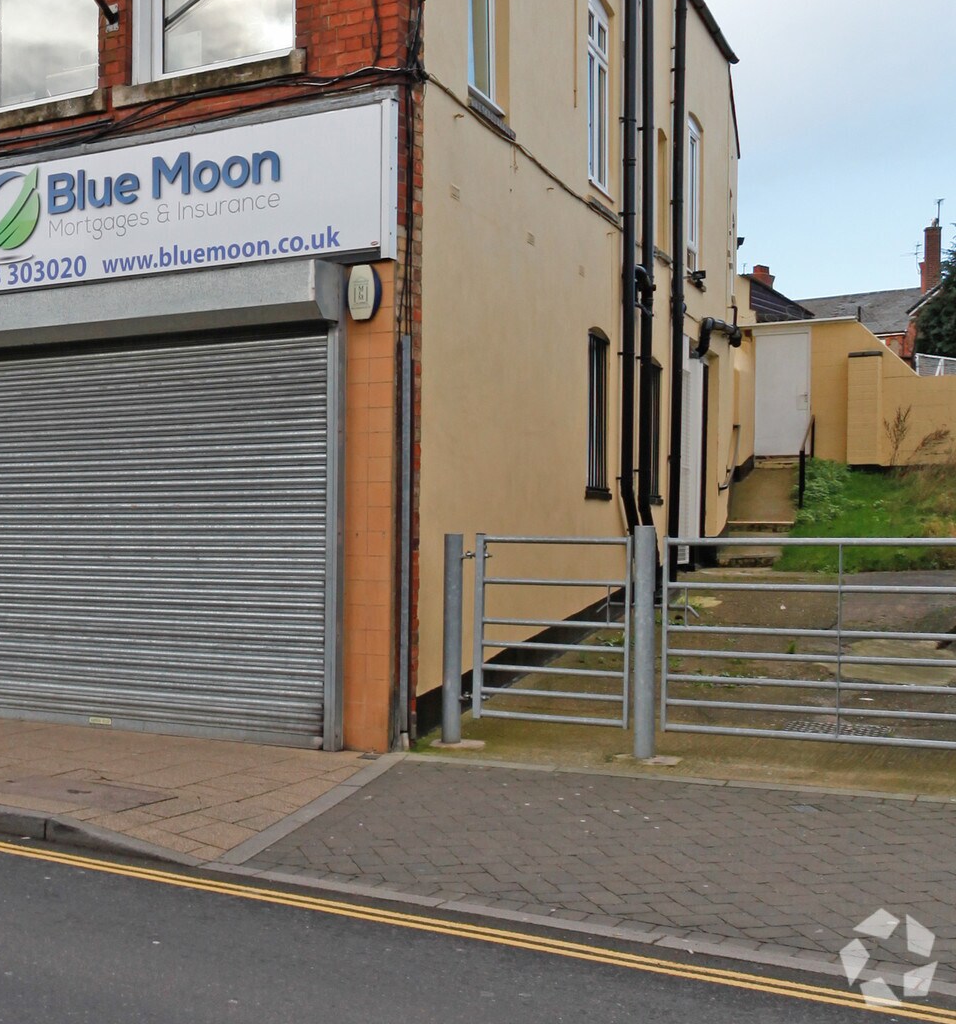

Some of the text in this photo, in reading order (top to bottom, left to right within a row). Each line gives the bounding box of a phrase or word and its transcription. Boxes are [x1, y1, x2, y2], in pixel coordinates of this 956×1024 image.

[47, 150, 281, 215] Blue Moon
[48, 192, 281, 240] Mortgages & Insurance
[7, 255, 87, 285] 303020
[102, 225, 341, 274] www.bluemoon.co.uk
